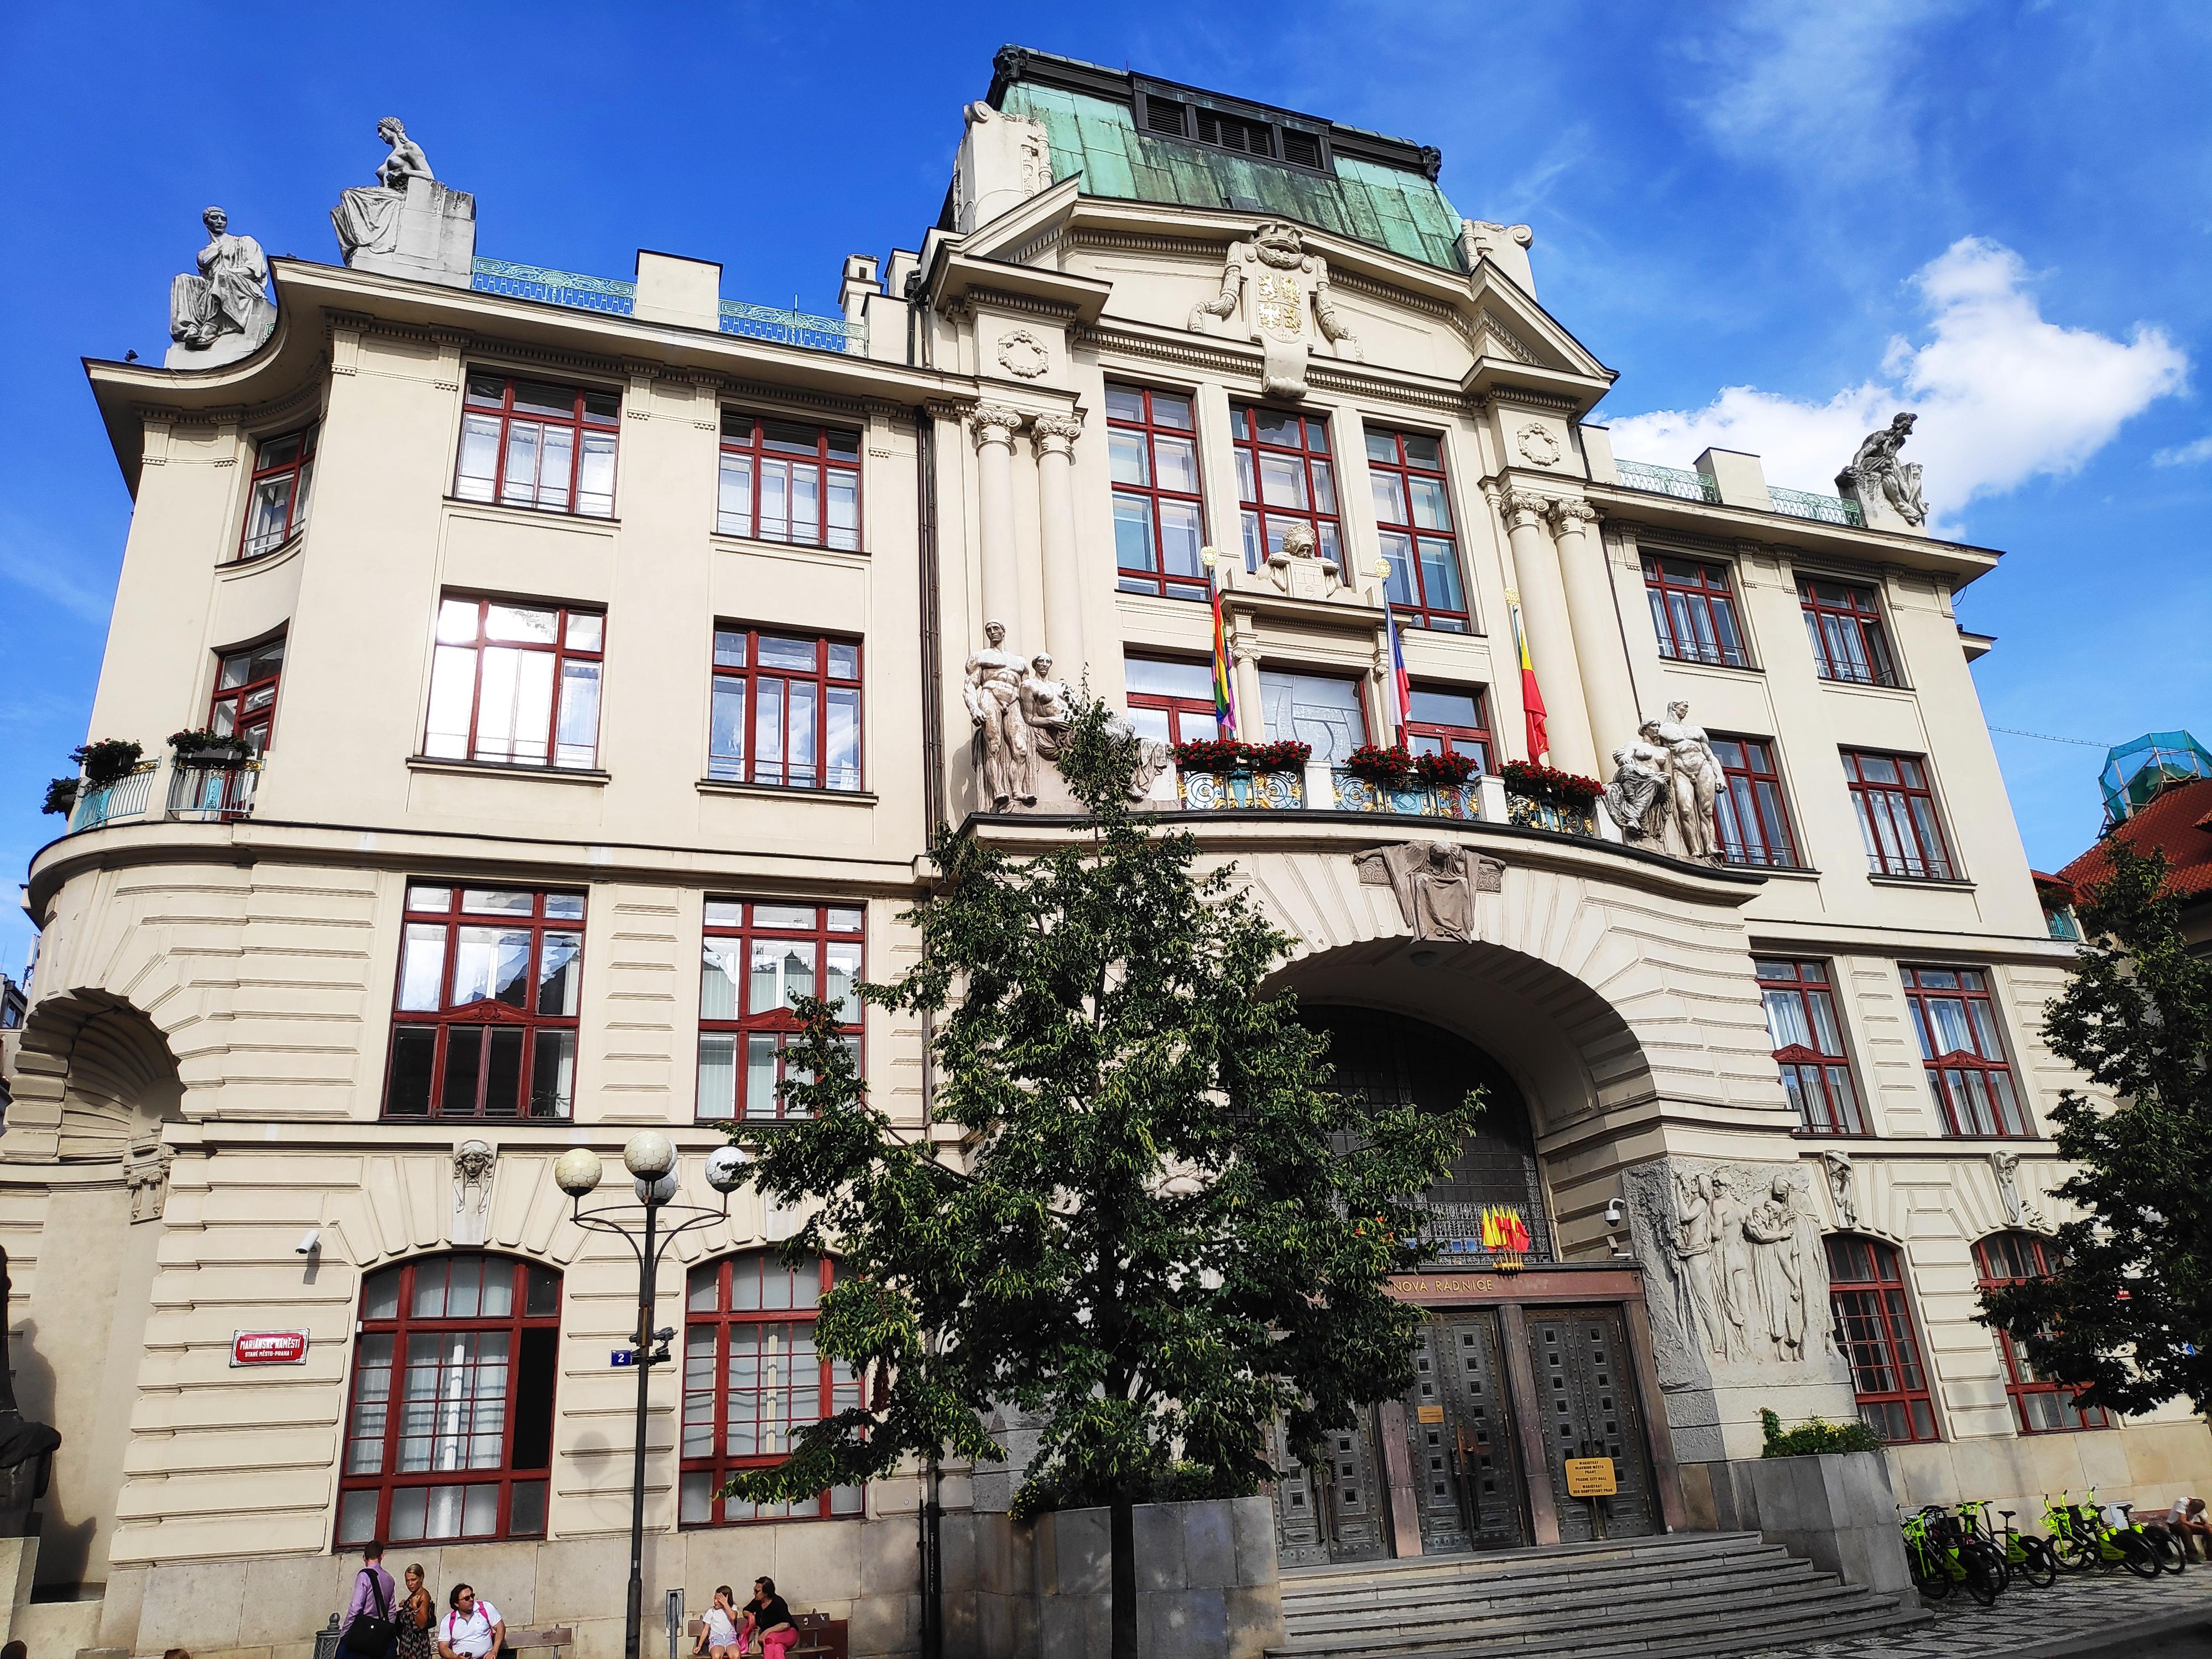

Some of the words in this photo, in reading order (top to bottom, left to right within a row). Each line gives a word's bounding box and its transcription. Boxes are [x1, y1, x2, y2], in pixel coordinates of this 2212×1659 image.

[1393, 1279, 1428, 1292] NOVÁ
[1434, 1280, 1493, 1292] RADNICE
[240, 1338, 274, 1350] MARIÁNSKÉ
[618, 1353, 624, 1363] 2
